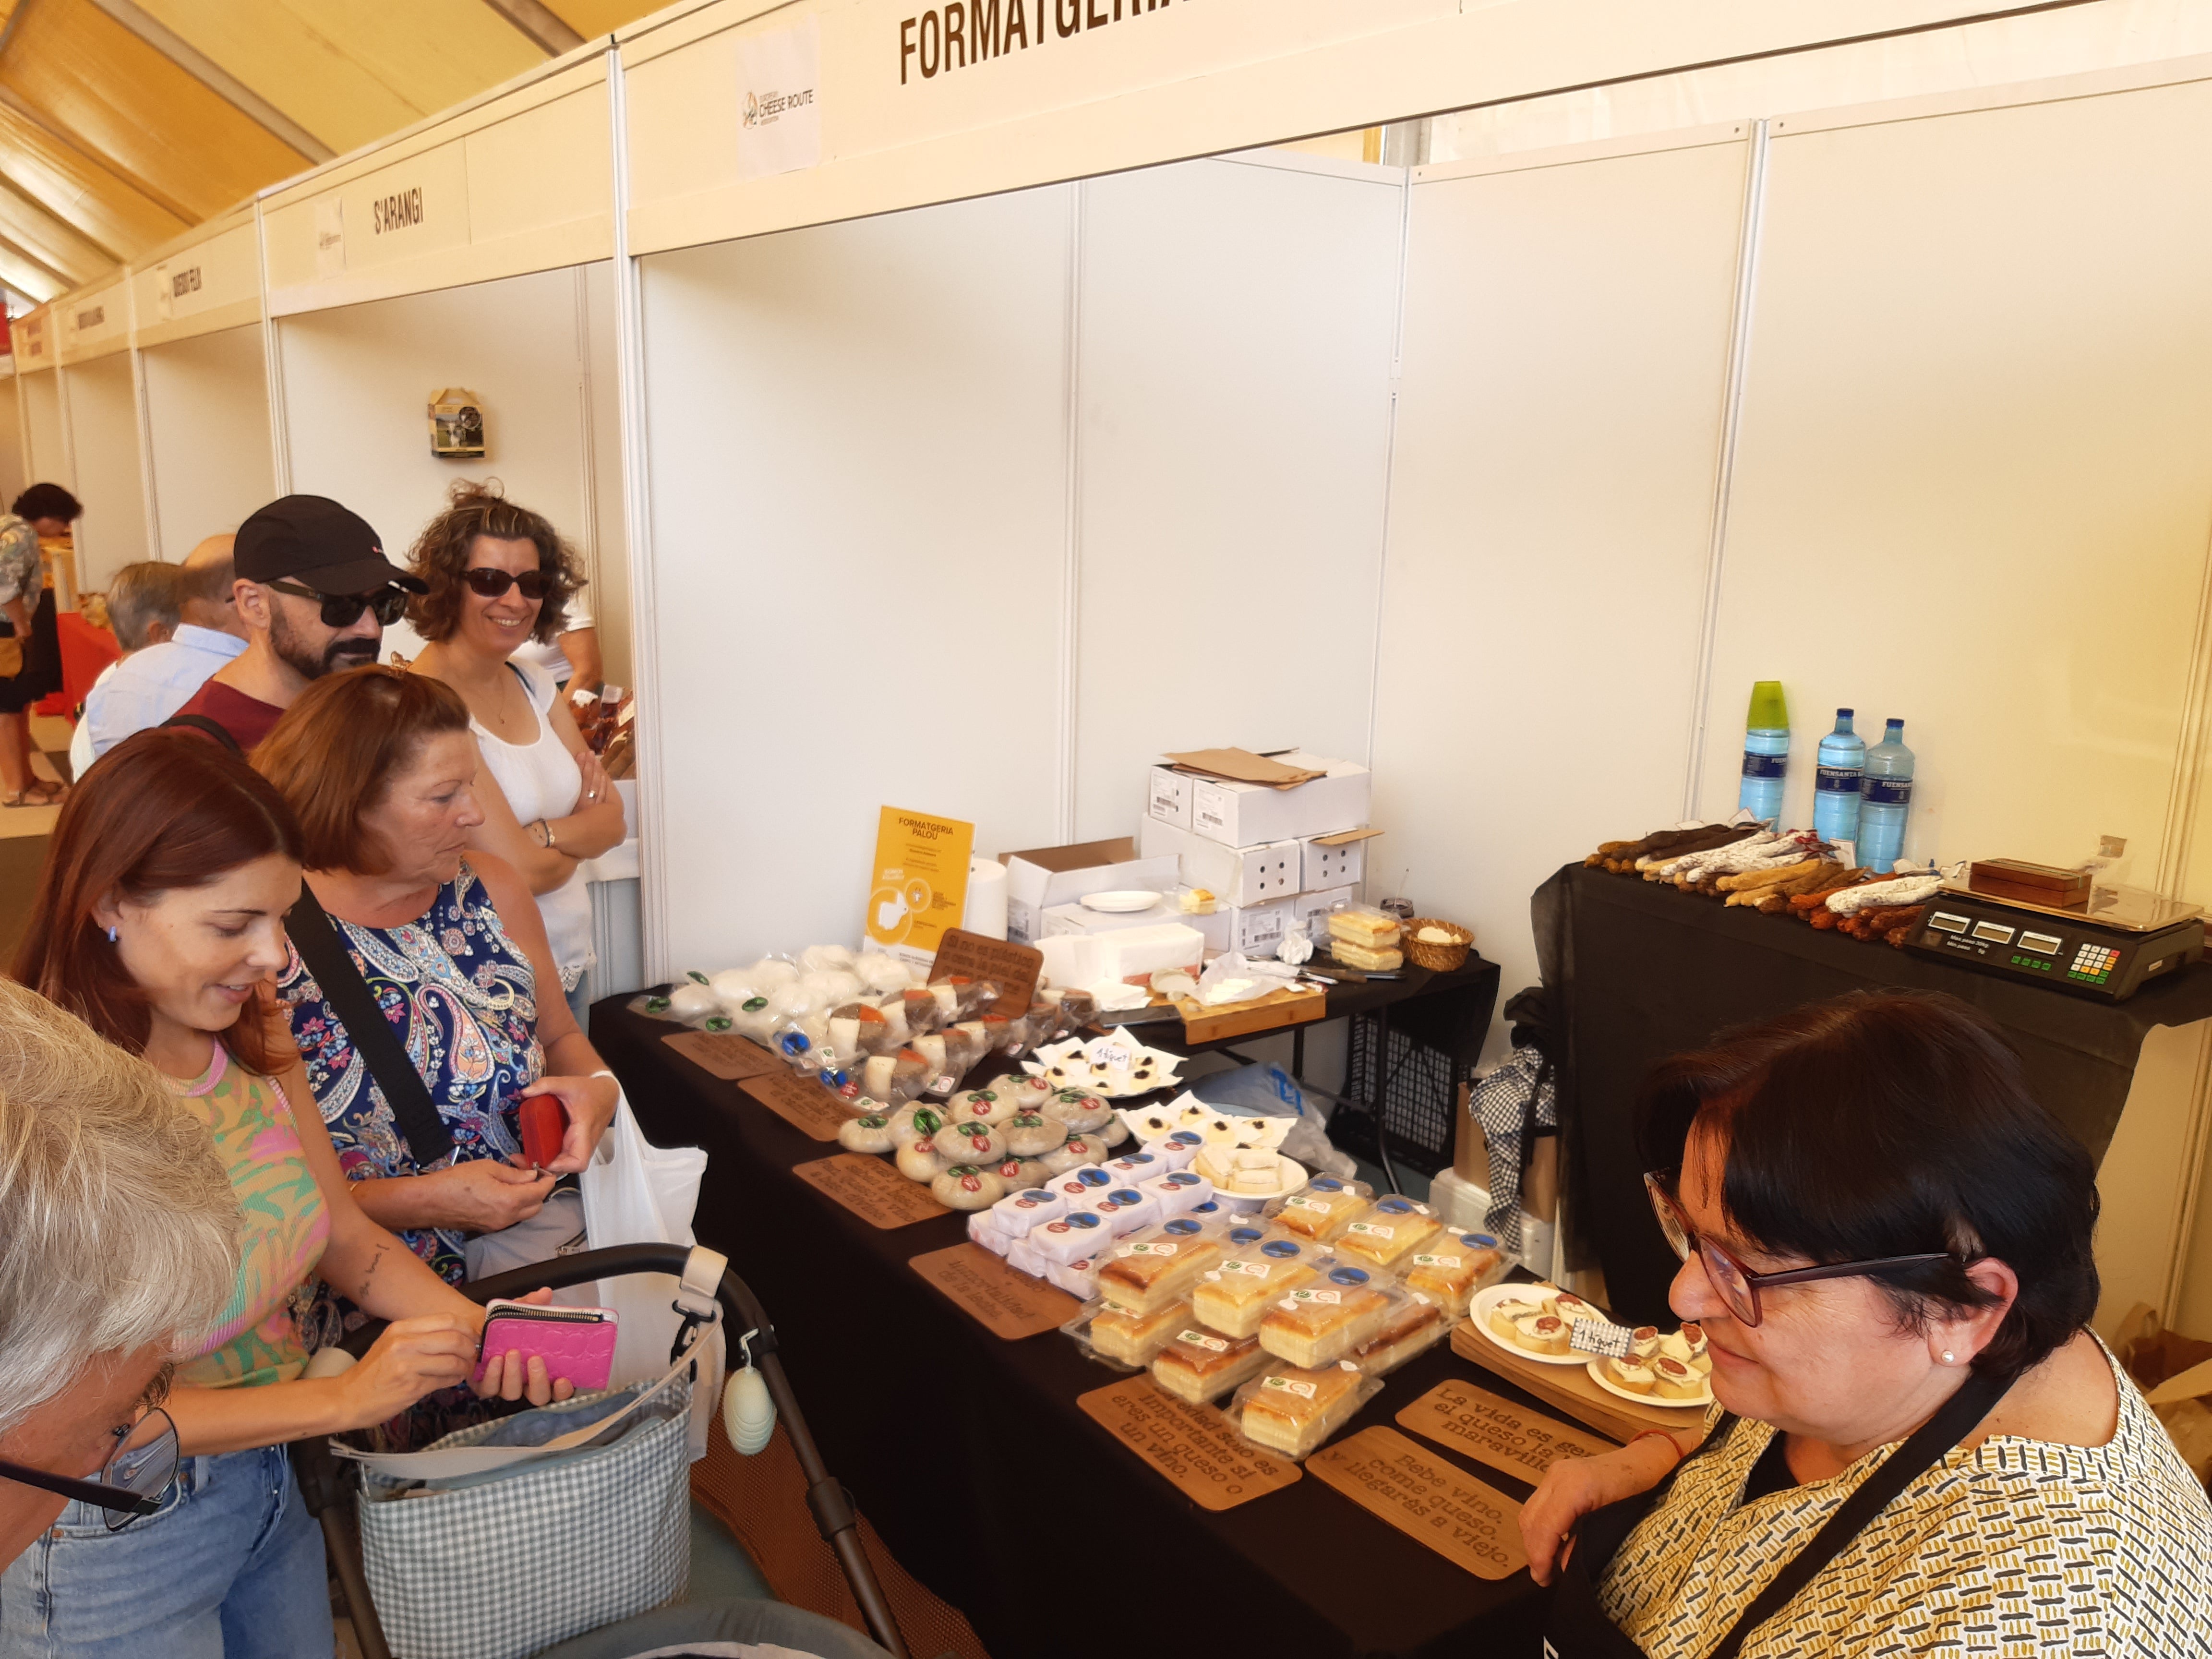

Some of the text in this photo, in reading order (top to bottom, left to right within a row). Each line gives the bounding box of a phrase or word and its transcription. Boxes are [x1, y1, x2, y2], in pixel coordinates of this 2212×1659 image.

[900, 0, 1192, 85] FORMATG
[759, 97, 786, 118] CHEESE
[787, 89, 814, 109] ROUTE
[374, 187, 424, 235] S'ARANGI
[899, 817, 953, 835] FORMATGERIA
[913, 828, 938, 840] PALOU
[1579, 1330, 1585, 1341] 1
[1120, 1421, 1147, 1443] un
[1434, 1402, 1558, 1459] el queso la
[1436, 1388, 1467, 1406] La
[1475, 1402, 1523, 1431] vida
[1526, 1426, 1554, 1444] es
[1111, 1395, 1243, 1494] eres un queso o
[1139, 1394, 1258, 1480] importante si
[1254, 1460, 1279, 1476] es
[1369, 1458, 1428, 1495] come
[1394, 1454, 1447, 1487] Bebe
[1430, 1515, 1448, 1528] a
